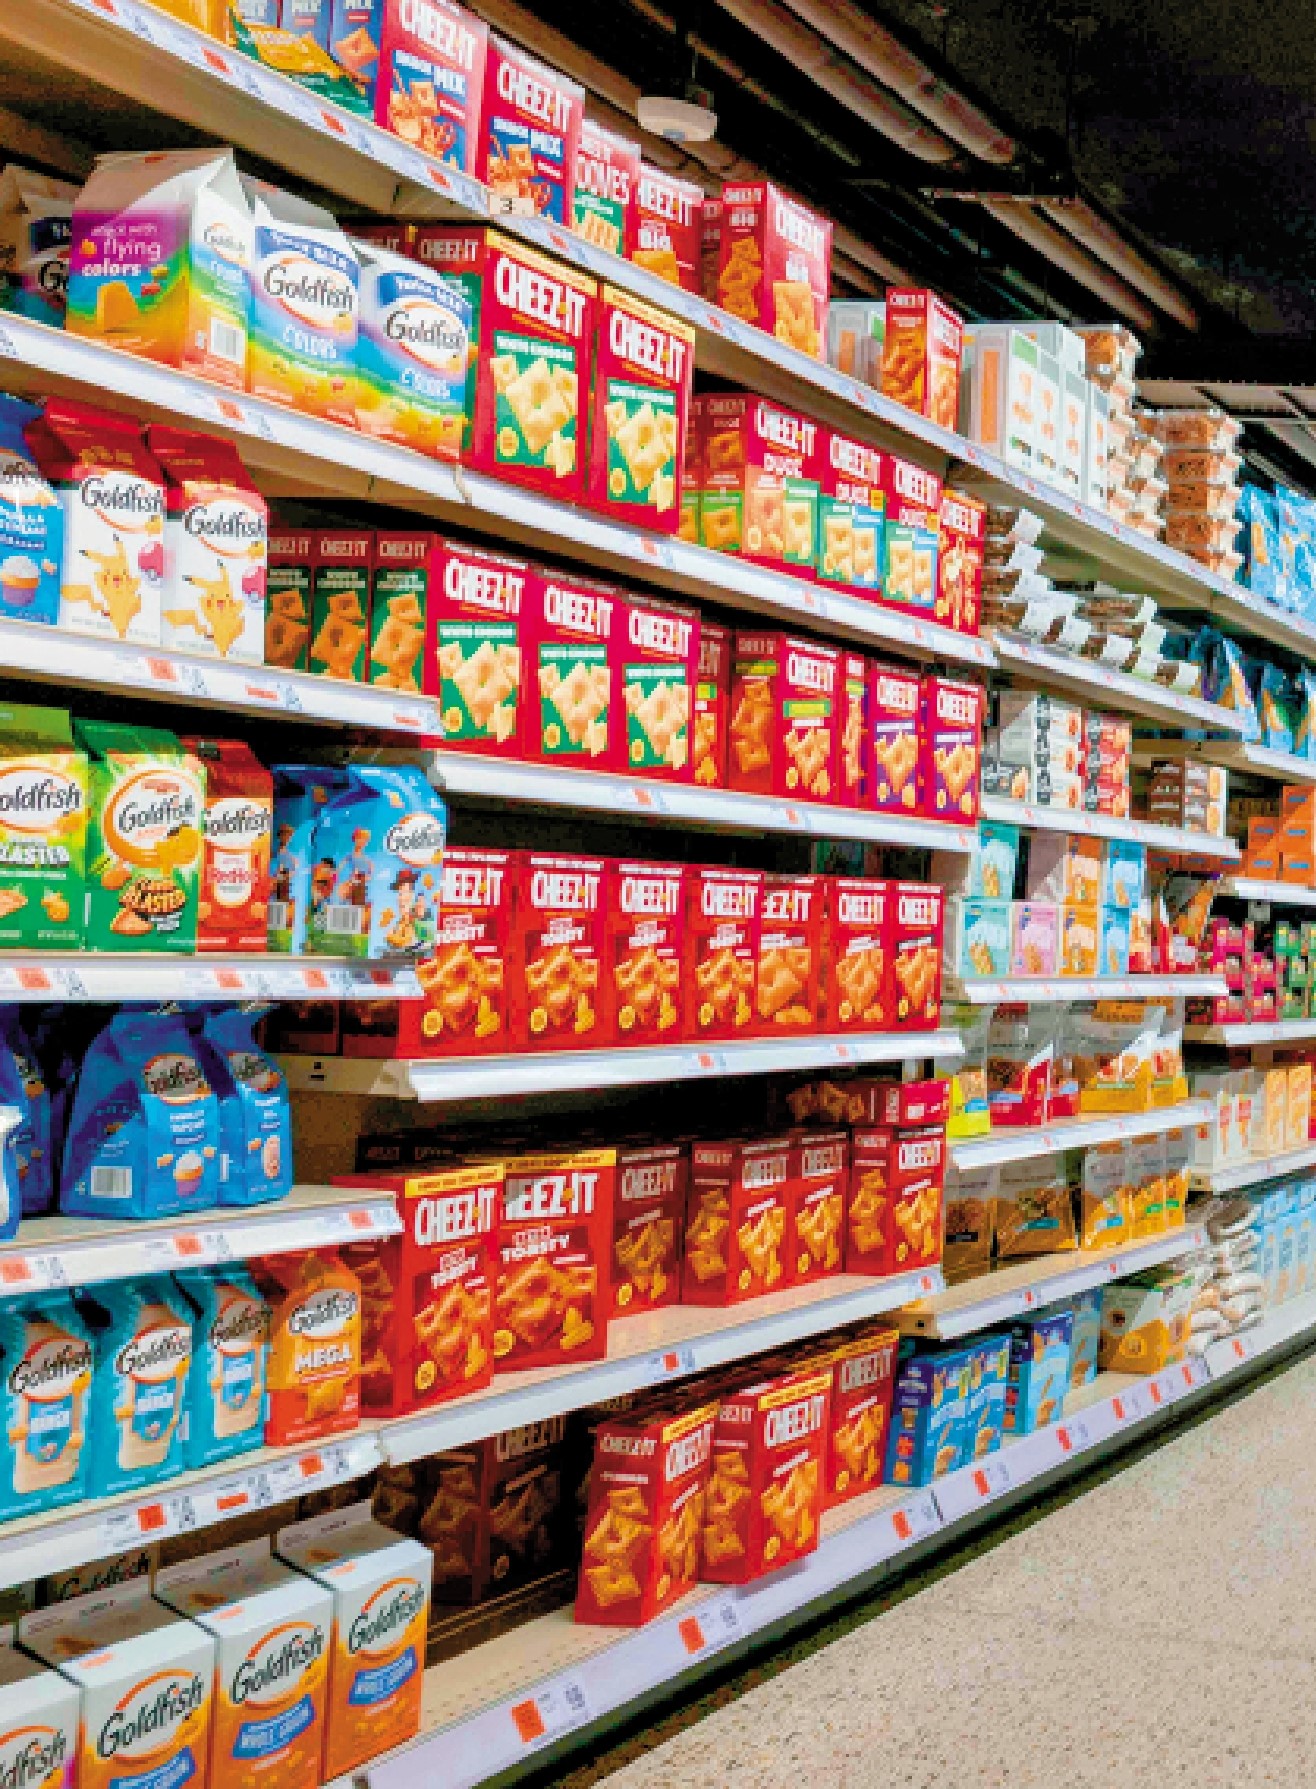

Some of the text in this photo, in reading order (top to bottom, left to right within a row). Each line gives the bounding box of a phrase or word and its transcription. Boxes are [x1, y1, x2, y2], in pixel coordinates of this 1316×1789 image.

[637, 179, 694, 227] HEEZ-IT
[82, 260, 142, 278] colors
[103, 238, 162, 262] flying
[263, 263, 355, 311] Goldfish
[386, 309, 467, 352] Goldfish
[81, 476, 165, 515] Goldfish
[183, 504, 267, 540] Goldfish
[0, 778, 81, 813] oldfish
[441, 867, 504, 907] HEEZ-IT
[293, 1342, 353, 1375] MEGA
[347, 1583, 427, 1656] Goldfish
[230, 1624, 326, 1705] Goldfish
[96, 1672, 205, 1760] Goldfish
